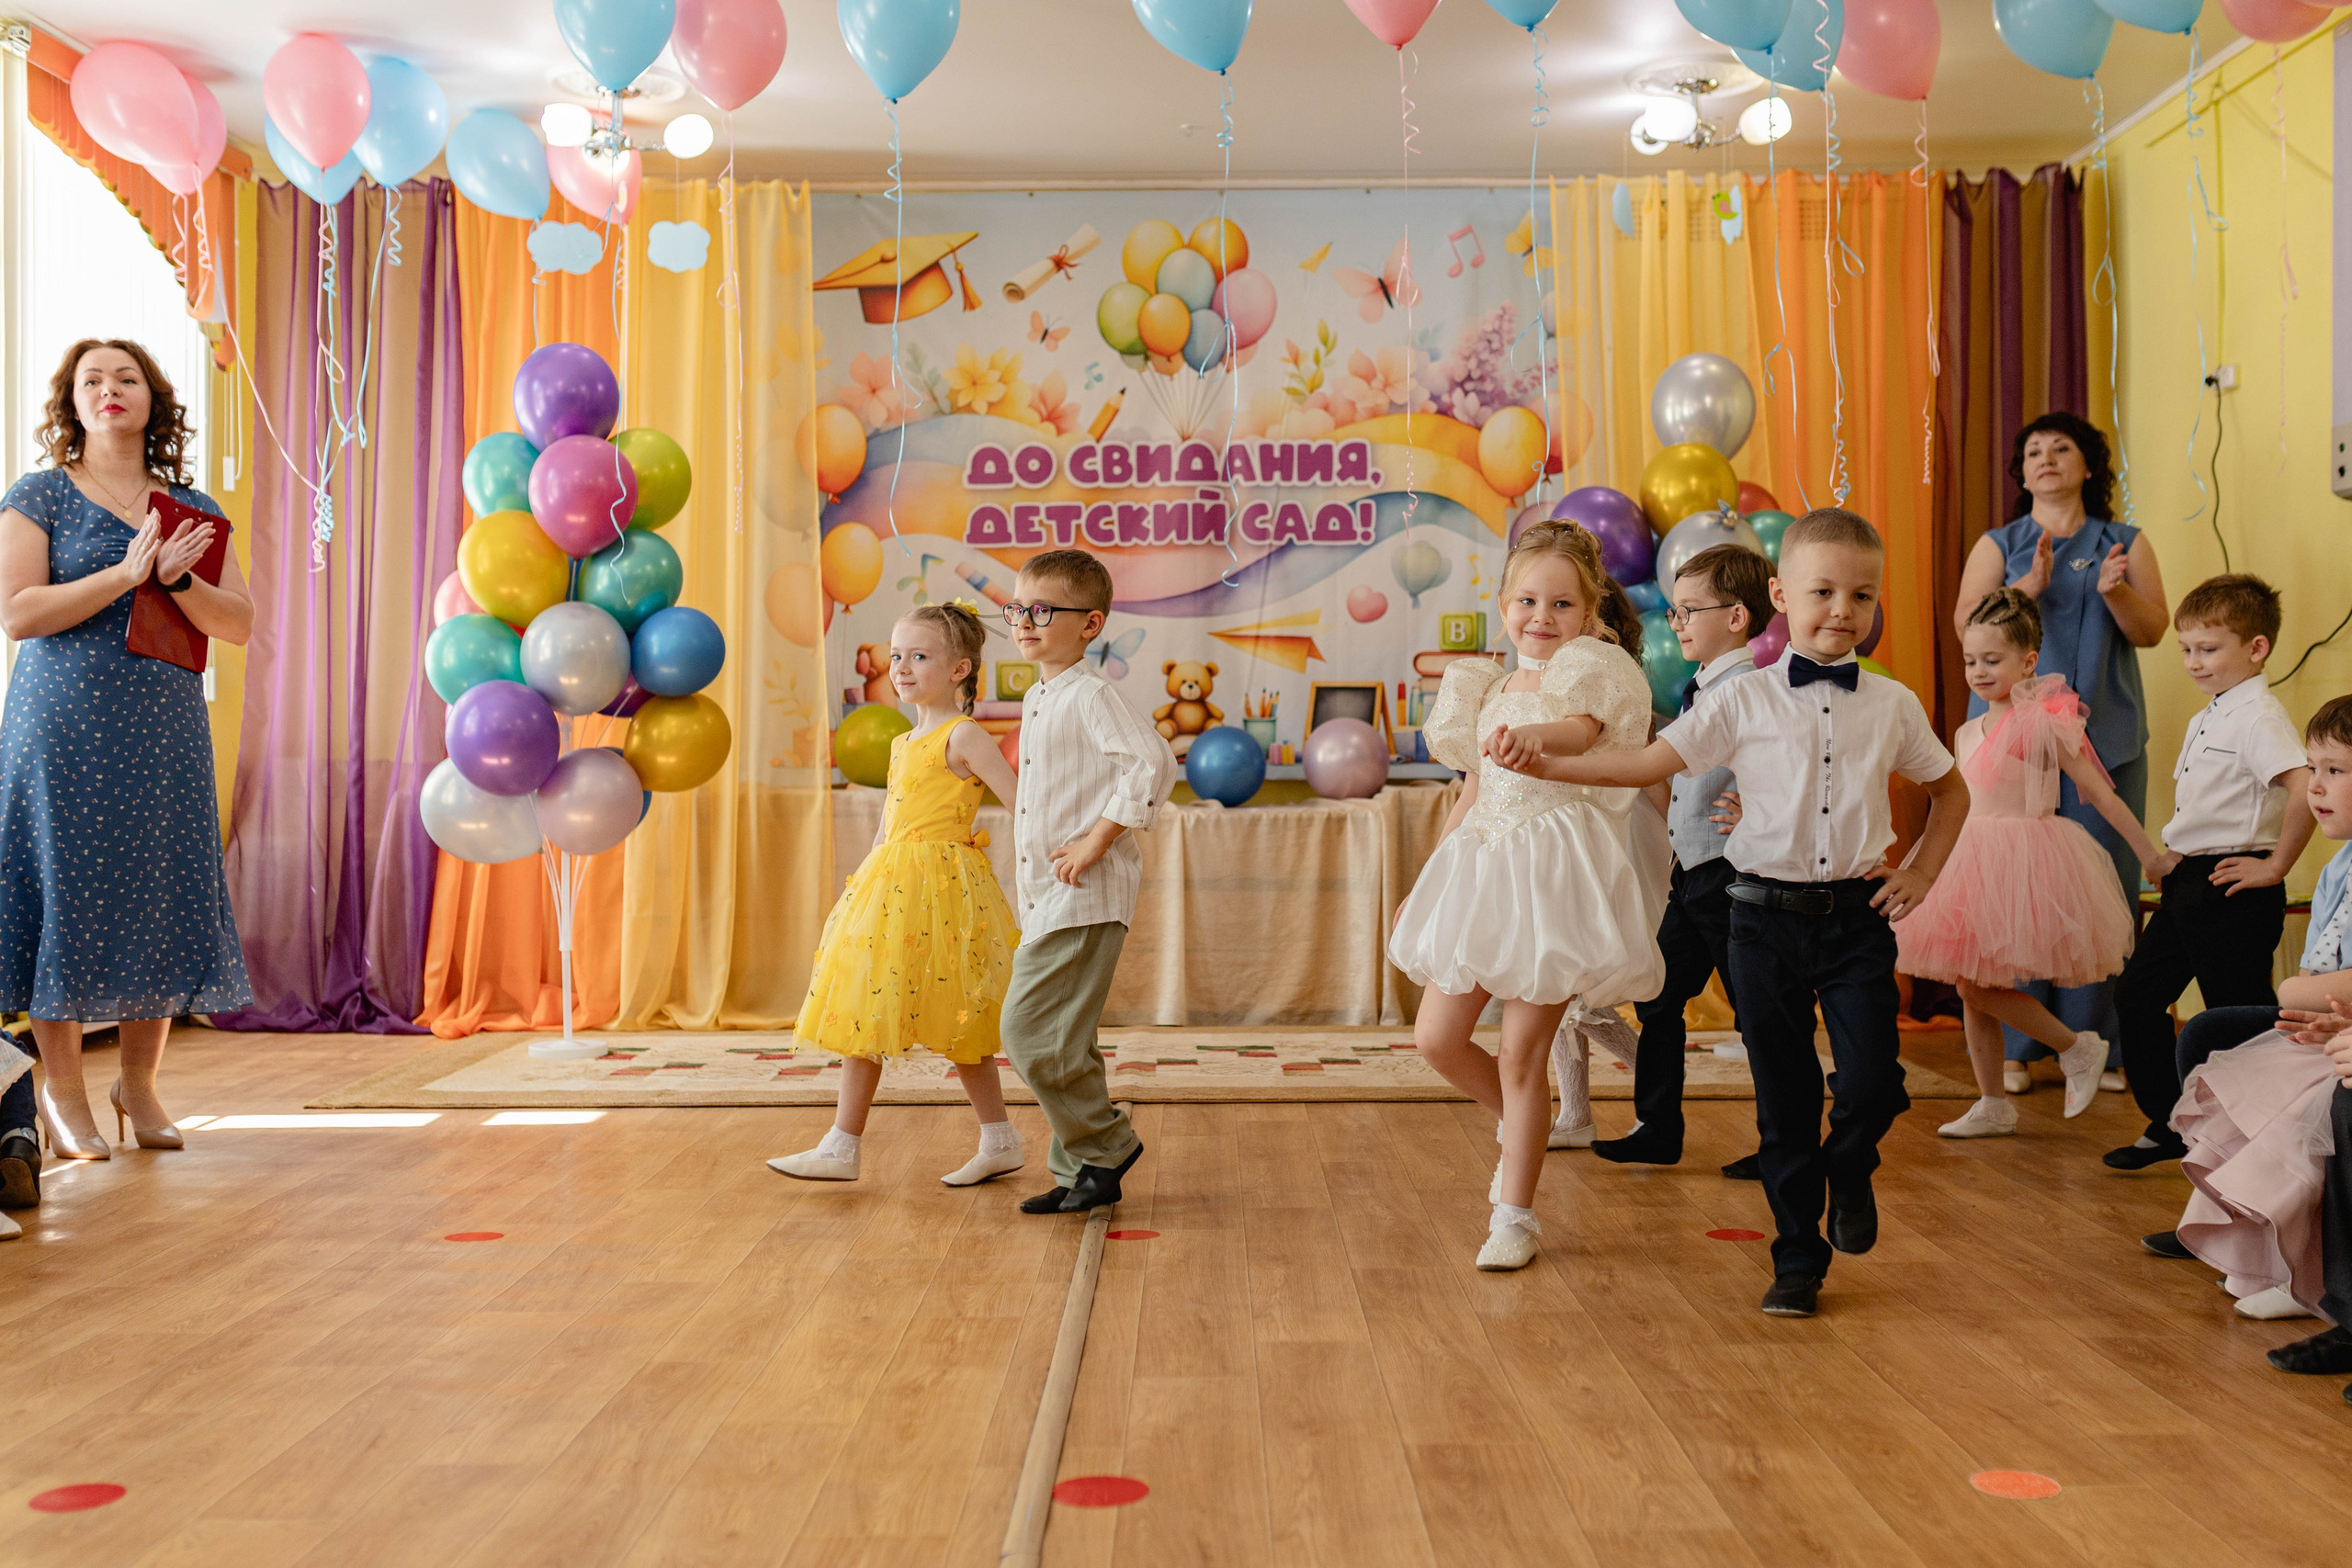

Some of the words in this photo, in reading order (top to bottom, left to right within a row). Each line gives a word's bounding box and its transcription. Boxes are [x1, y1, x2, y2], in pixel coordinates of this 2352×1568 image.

[966, 444, 1056, 486] ДО
[1068, 441, 1383, 486] СВИДАНИЯ,
[965, 488, 1228, 545] ДЕТСКИЙ
[1240, 502, 1374, 543] САД!
[1450, 621, 1466, 643] B
[1008, 671, 1023, 693] C
